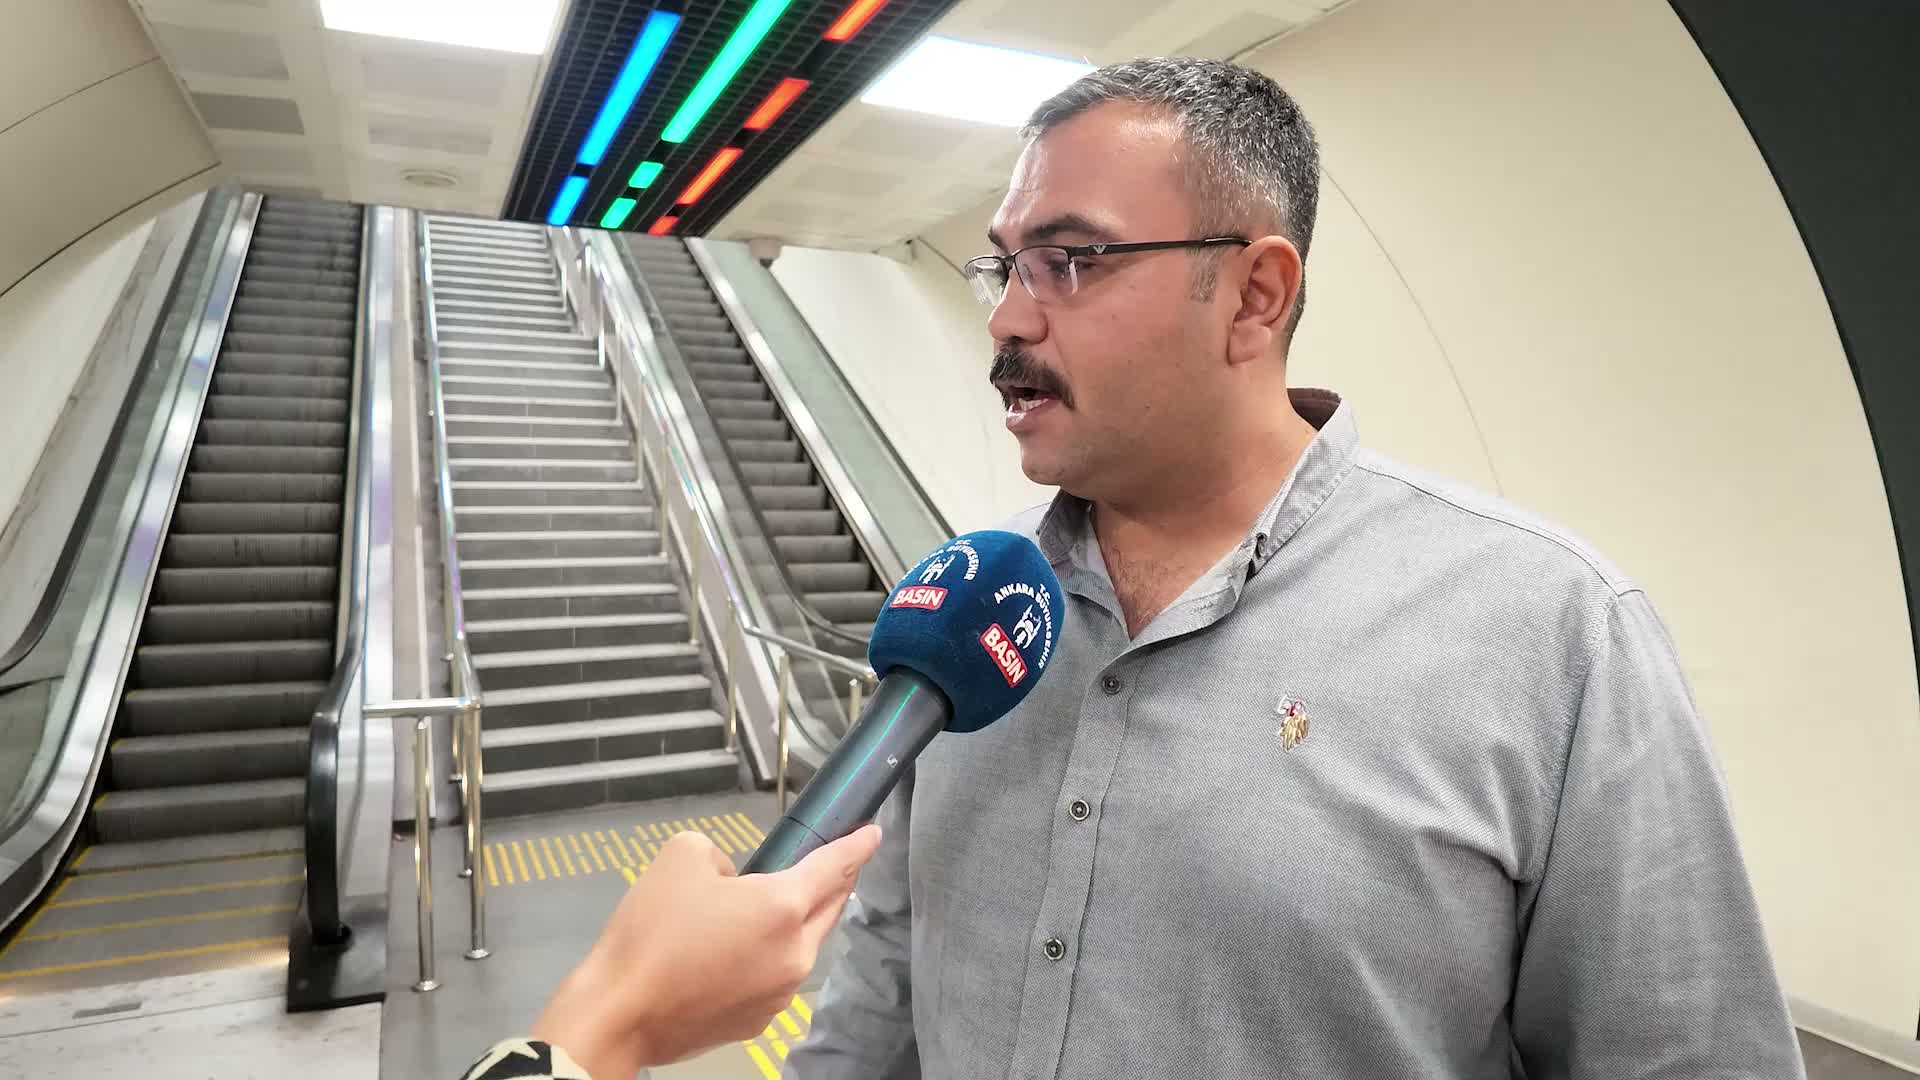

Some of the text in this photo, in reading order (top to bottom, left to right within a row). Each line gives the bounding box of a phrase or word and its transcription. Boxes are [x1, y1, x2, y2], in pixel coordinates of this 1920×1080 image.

[893, 589, 944, 607] BASIN
[994, 583, 1034, 604] ANKARA
[984, 627, 1026, 684] BASIN
